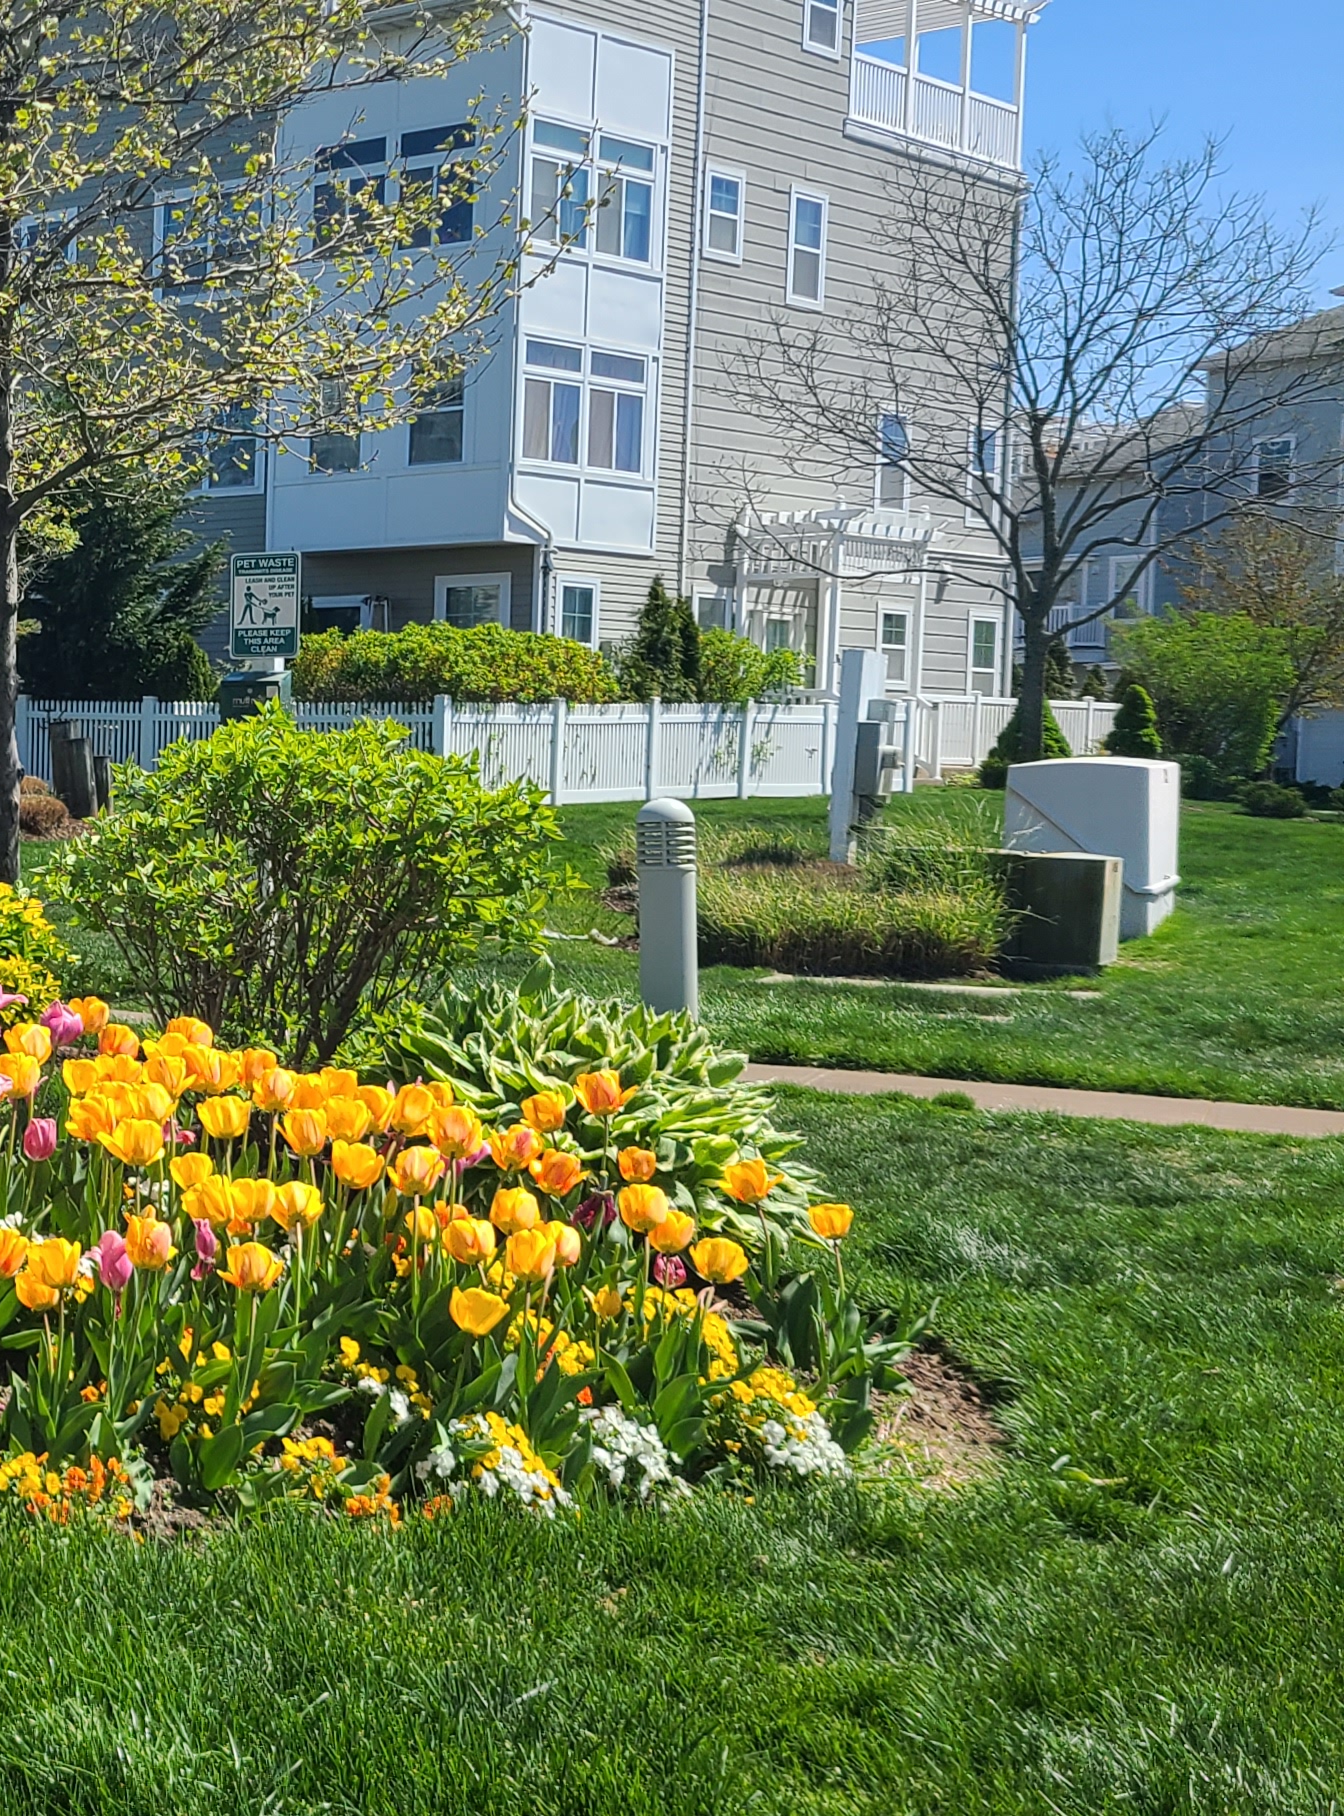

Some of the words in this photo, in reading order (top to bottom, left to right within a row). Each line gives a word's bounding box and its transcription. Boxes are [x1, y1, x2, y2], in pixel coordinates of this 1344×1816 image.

[237, 559, 257, 569] PET
[258, 558, 295, 568] WASTE
[263, 637, 286, 645] AREA
[250, 645, 278, 653] CLEAN
